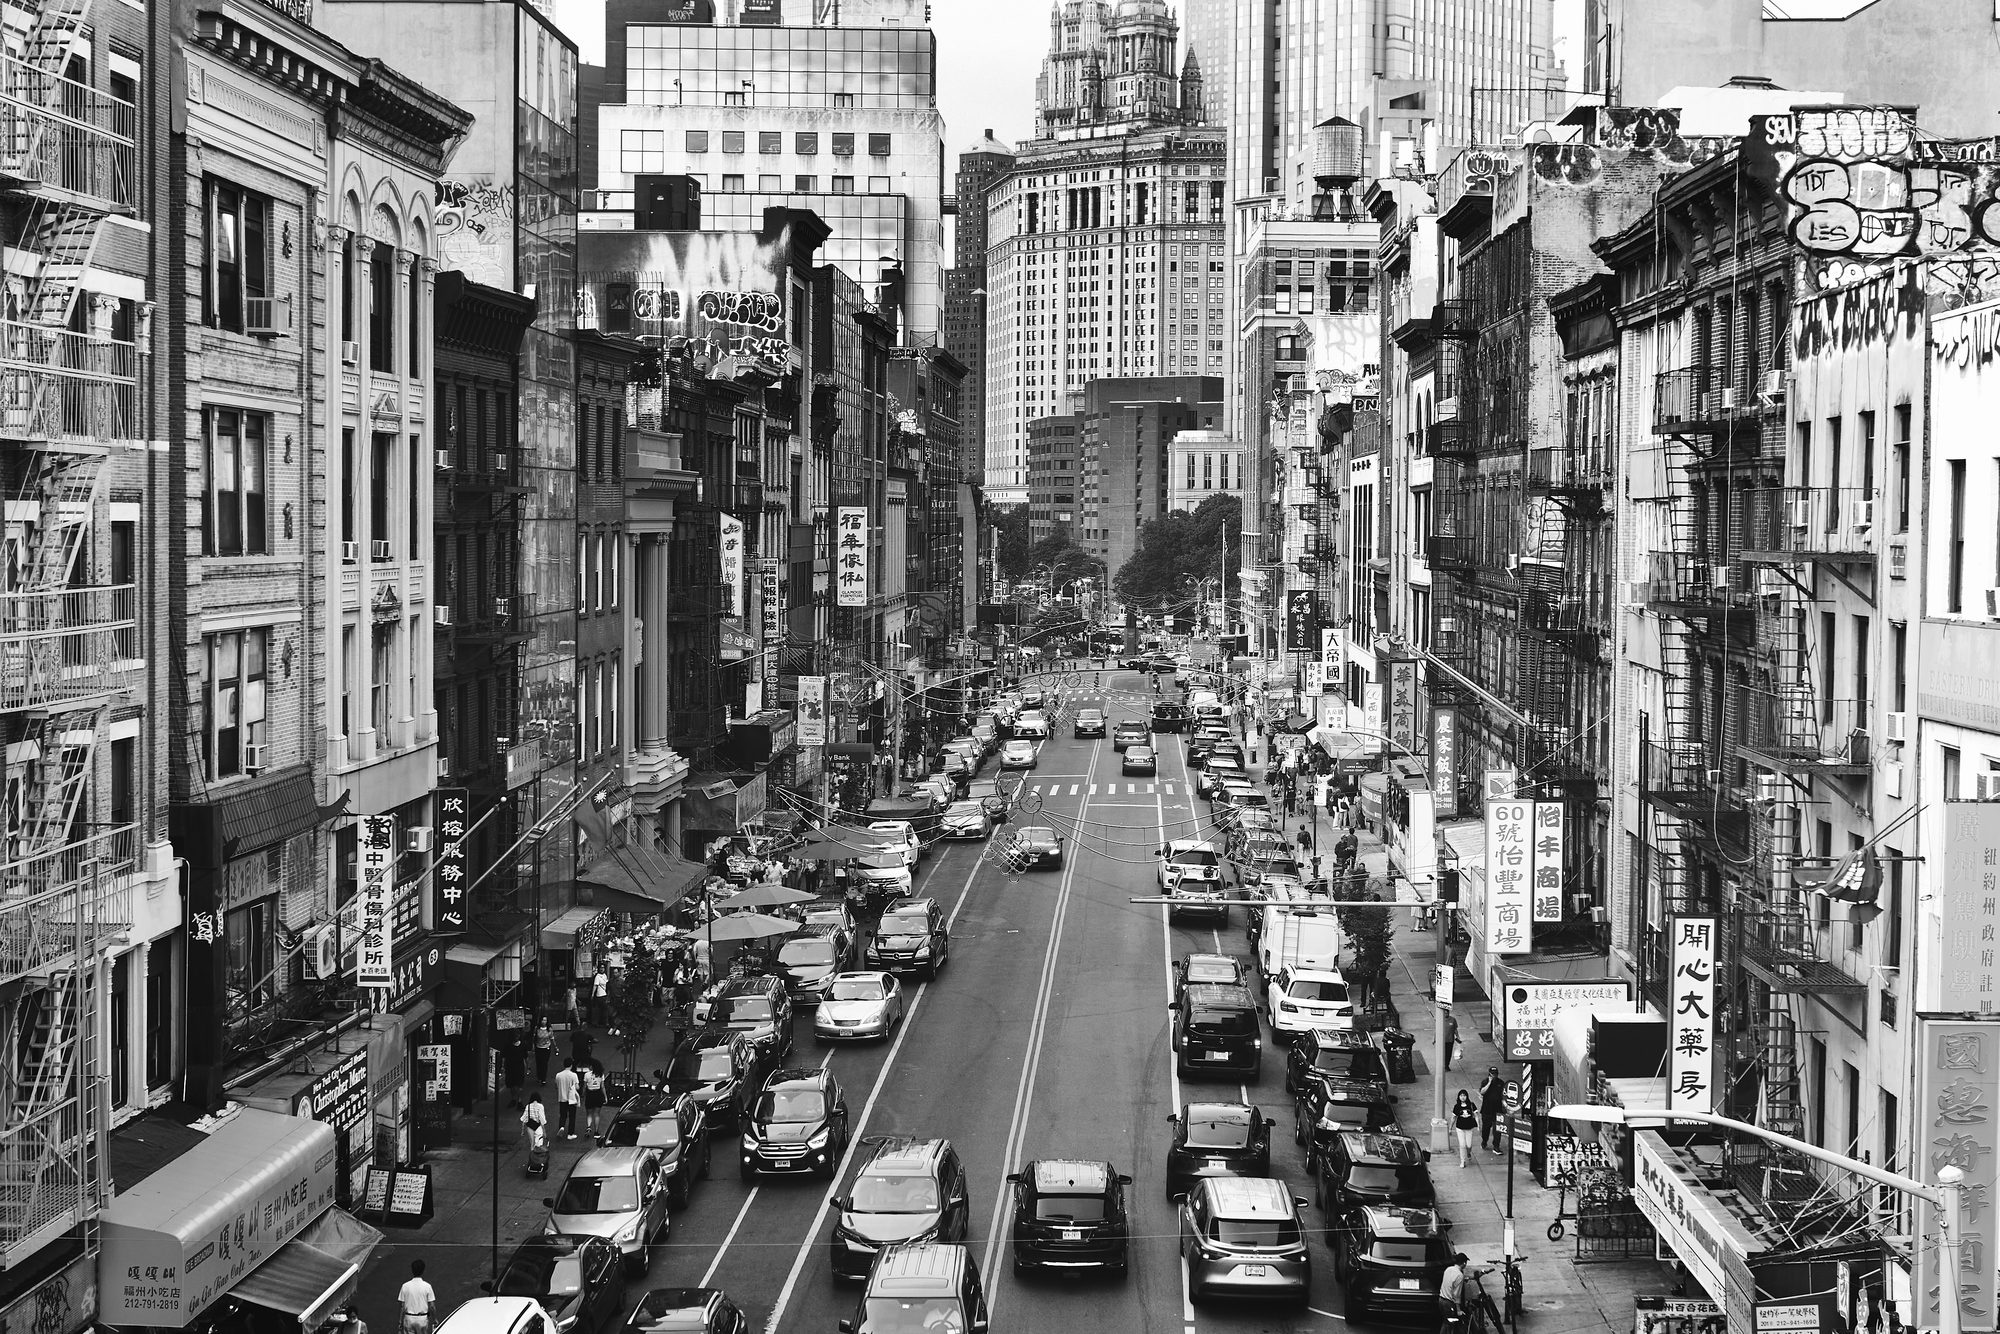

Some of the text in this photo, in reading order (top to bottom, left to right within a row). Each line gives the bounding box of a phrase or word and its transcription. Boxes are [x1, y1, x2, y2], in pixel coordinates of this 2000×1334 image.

[1808, 221, 1849, 242] LES
[1326, 632, 1340, 680] 大帝國
[1393, 665, 1414, 750] 華美商場
[1435, 715, 1453, 795] 農家飯莊
[441, 797, 465, 926] 欣榕服務中心
[1673, 924, 1711, 1100] 開心大藥房
[313, 1078, 348, 1114] Christopher
[348, 1066, 367, 1089] Marte
[263, 1177, 308, 1231] 福州小吃店
[123, 1285, 181, 1298] 福州小吃店
[124, 1298, 179, 1310] 212-791-2819
